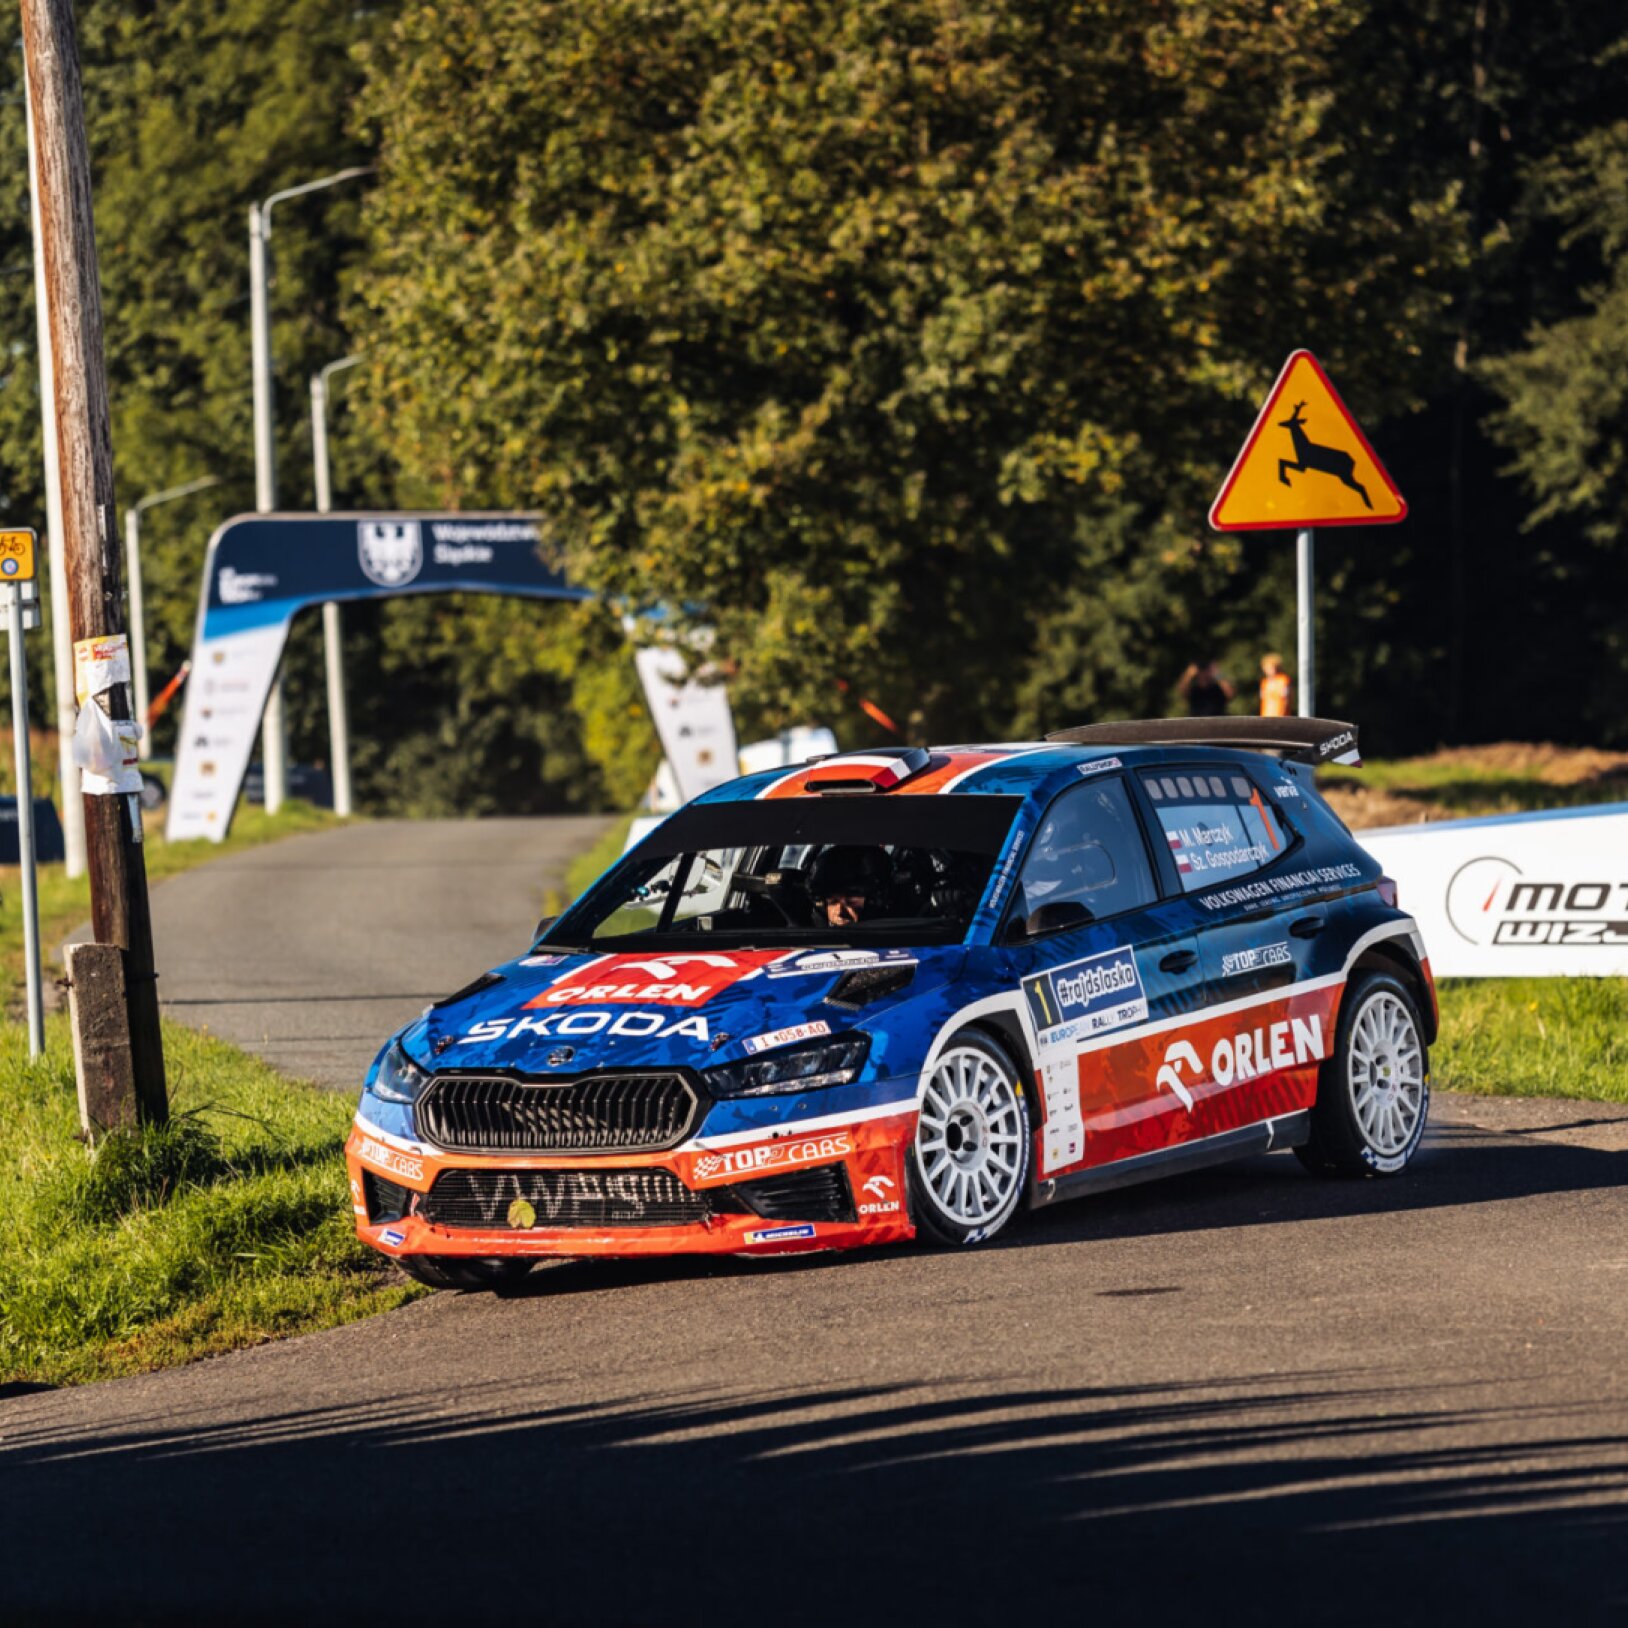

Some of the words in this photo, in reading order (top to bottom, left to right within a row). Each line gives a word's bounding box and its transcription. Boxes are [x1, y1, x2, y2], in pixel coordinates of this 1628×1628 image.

[1250, 787, 1280, 850] 1
[1179, 828, 1195, 848] M.
[1192, 823, 1233, 845] Marczyk
[1206, 842, 1269, 869] Gospodarczyk
[1199, 881, 1273, 910] VOLKSWAGEN
[1268, 870, 1320, 892] FINANCIAL
[1318, 864, 1361, 882] SERVICES
[547, 983, 711, 1002] ORLEN
[1035, 980, 1053, 1025] 1
[1212, 1014, 1324, 1086] ORLEN
[393, 1155, 424, 1182] CARS
[722, 1146, 771, 1172] TOP
[788, 1136, 851, 1163] CARS
[858, 1201, 900, 1214] ORLEN
